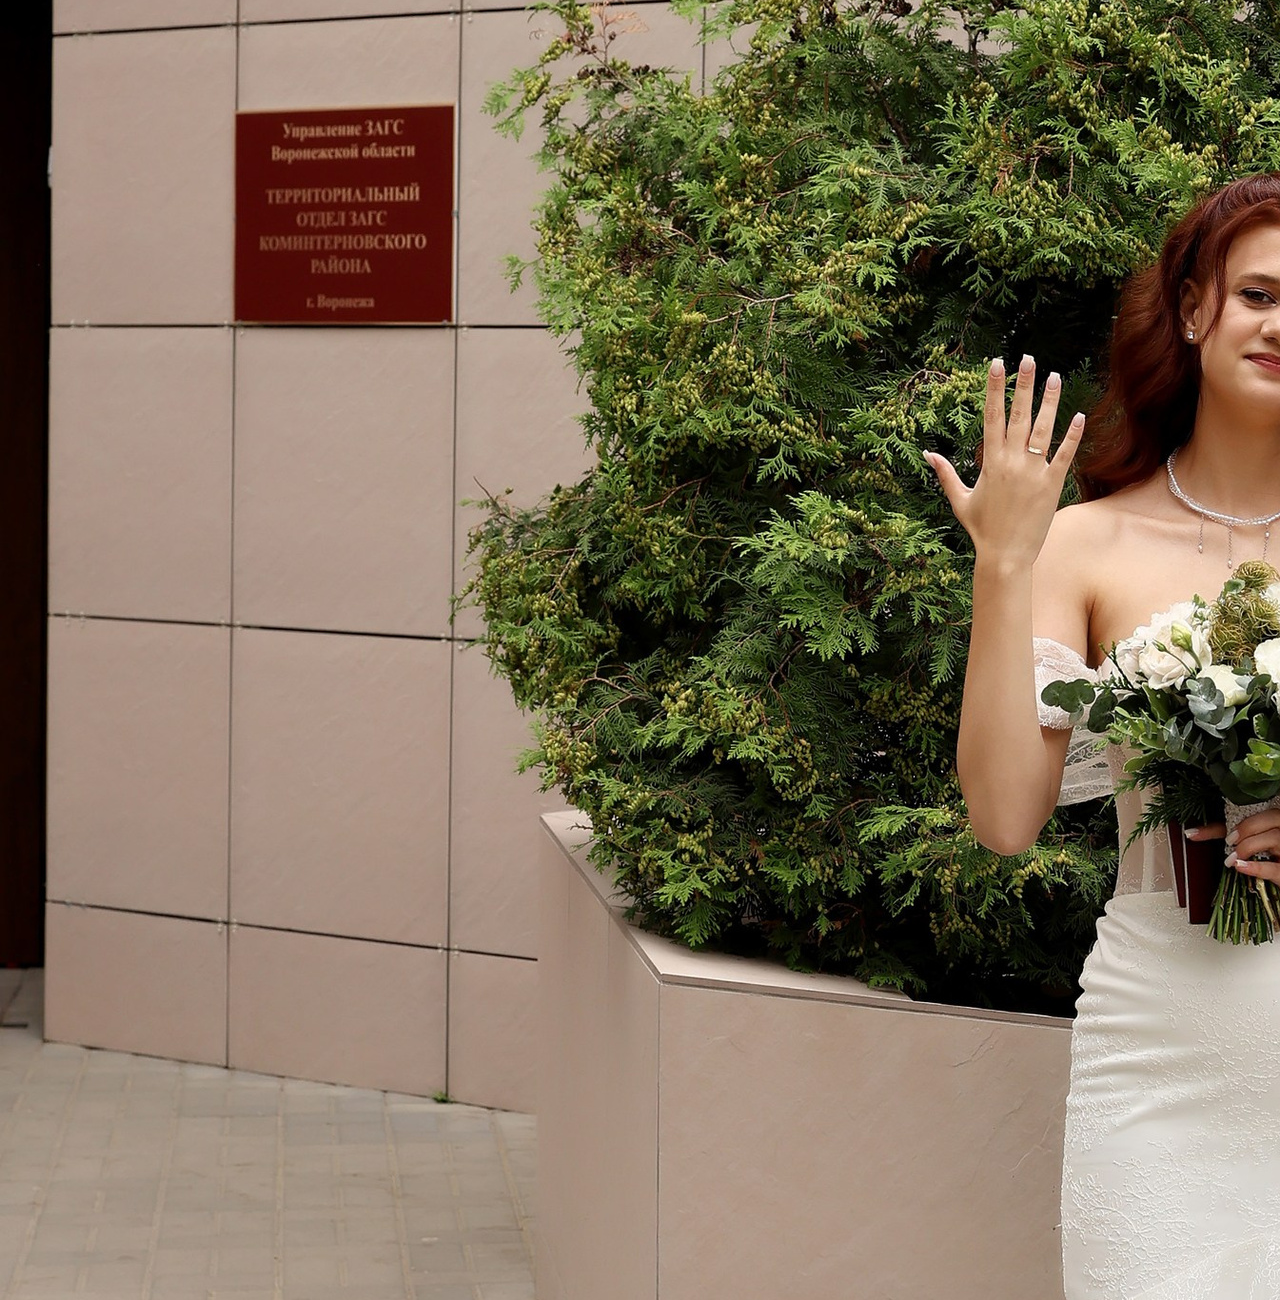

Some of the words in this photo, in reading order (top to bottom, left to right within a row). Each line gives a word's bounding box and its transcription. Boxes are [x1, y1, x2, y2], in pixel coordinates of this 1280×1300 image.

[283, 123, 362, 141] Управление
[364, 119, 405, 136] ЗАГС
[271, 144, 359, 164] Воронежской
[361, 142, 416, 159] области
[265, 183, 421, 204] ТЕРРИТОРИАЛЬНЫЙ
[296, 211, 346, 228] ОТДЕЛ
[349, 210, 388, 227] ЗАГС
[259, 233, 428, 251] КОМИНТЕРНОВСКОГО
[311, 256, 372, 274] РАЙОНА
